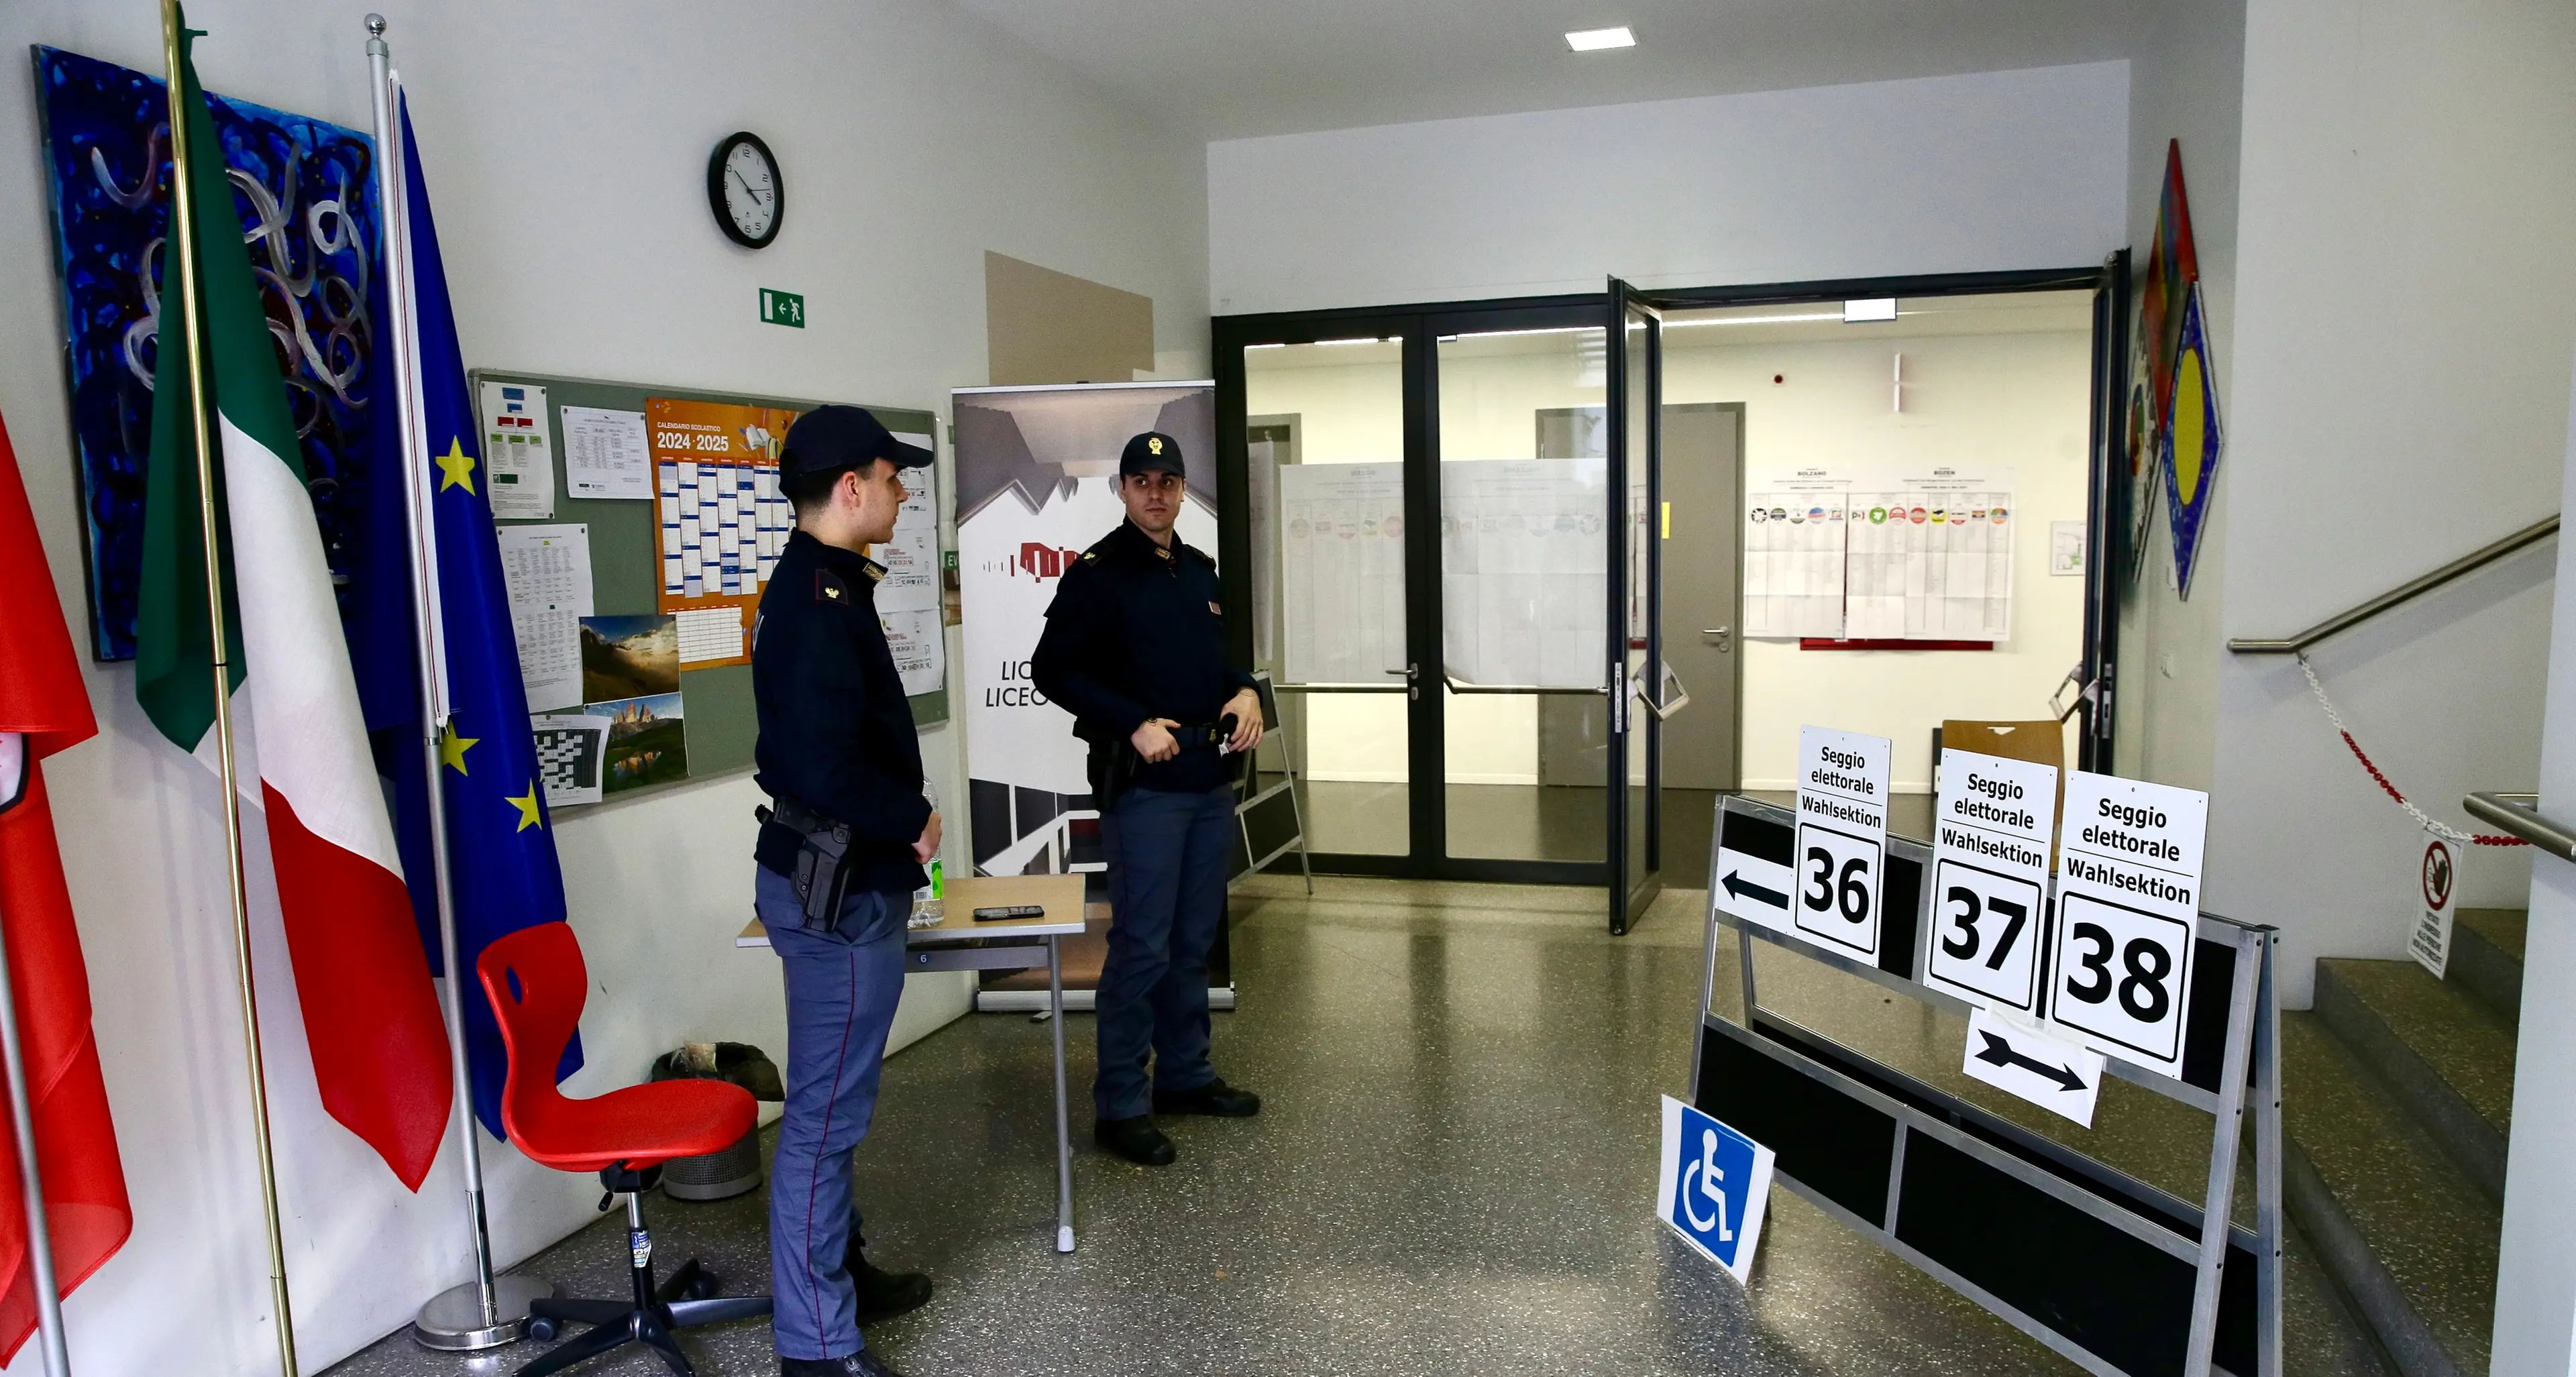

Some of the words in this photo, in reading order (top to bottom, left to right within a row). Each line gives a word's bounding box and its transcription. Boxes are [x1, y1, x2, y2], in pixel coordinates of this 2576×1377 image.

[762, 174, 768, 182] 2
[766, 192, 771, 201] 3
[745, 225, 751, 233] 6
[755, 222, 761, 230] 5
[657, 421, 690, 430] CALENDARIO
[690, 424, 721, 432] SCOLASTICO
[657, 431, 691, 449] 2024
[696, 434, 729, 451] 2025
[985, 687, 1049, 707] LICEO
[1821, 746, 1865, 769] Seggio
[1811, 768, 1874, 795] elettorale
[1968, 773, 2023, 800] Seggio
[1802, 795, 1882, 829] Wahlsektion
[1954, 797, 2034, 830] elettorale
[2098, 797, 2167, 829] Seggio
[1942, 827, 2042, 868] Wahlsektion
[2082, 825, 2180, 862] elettorale
[1804, 846, 1870, 924] 36
[2068, 857, 2190, 905] Wahlsektion
[1942, 886, 2027, 971] 37
[920, 954, 927, 962] 6
[2067, 922, 2171, 1024] 38
